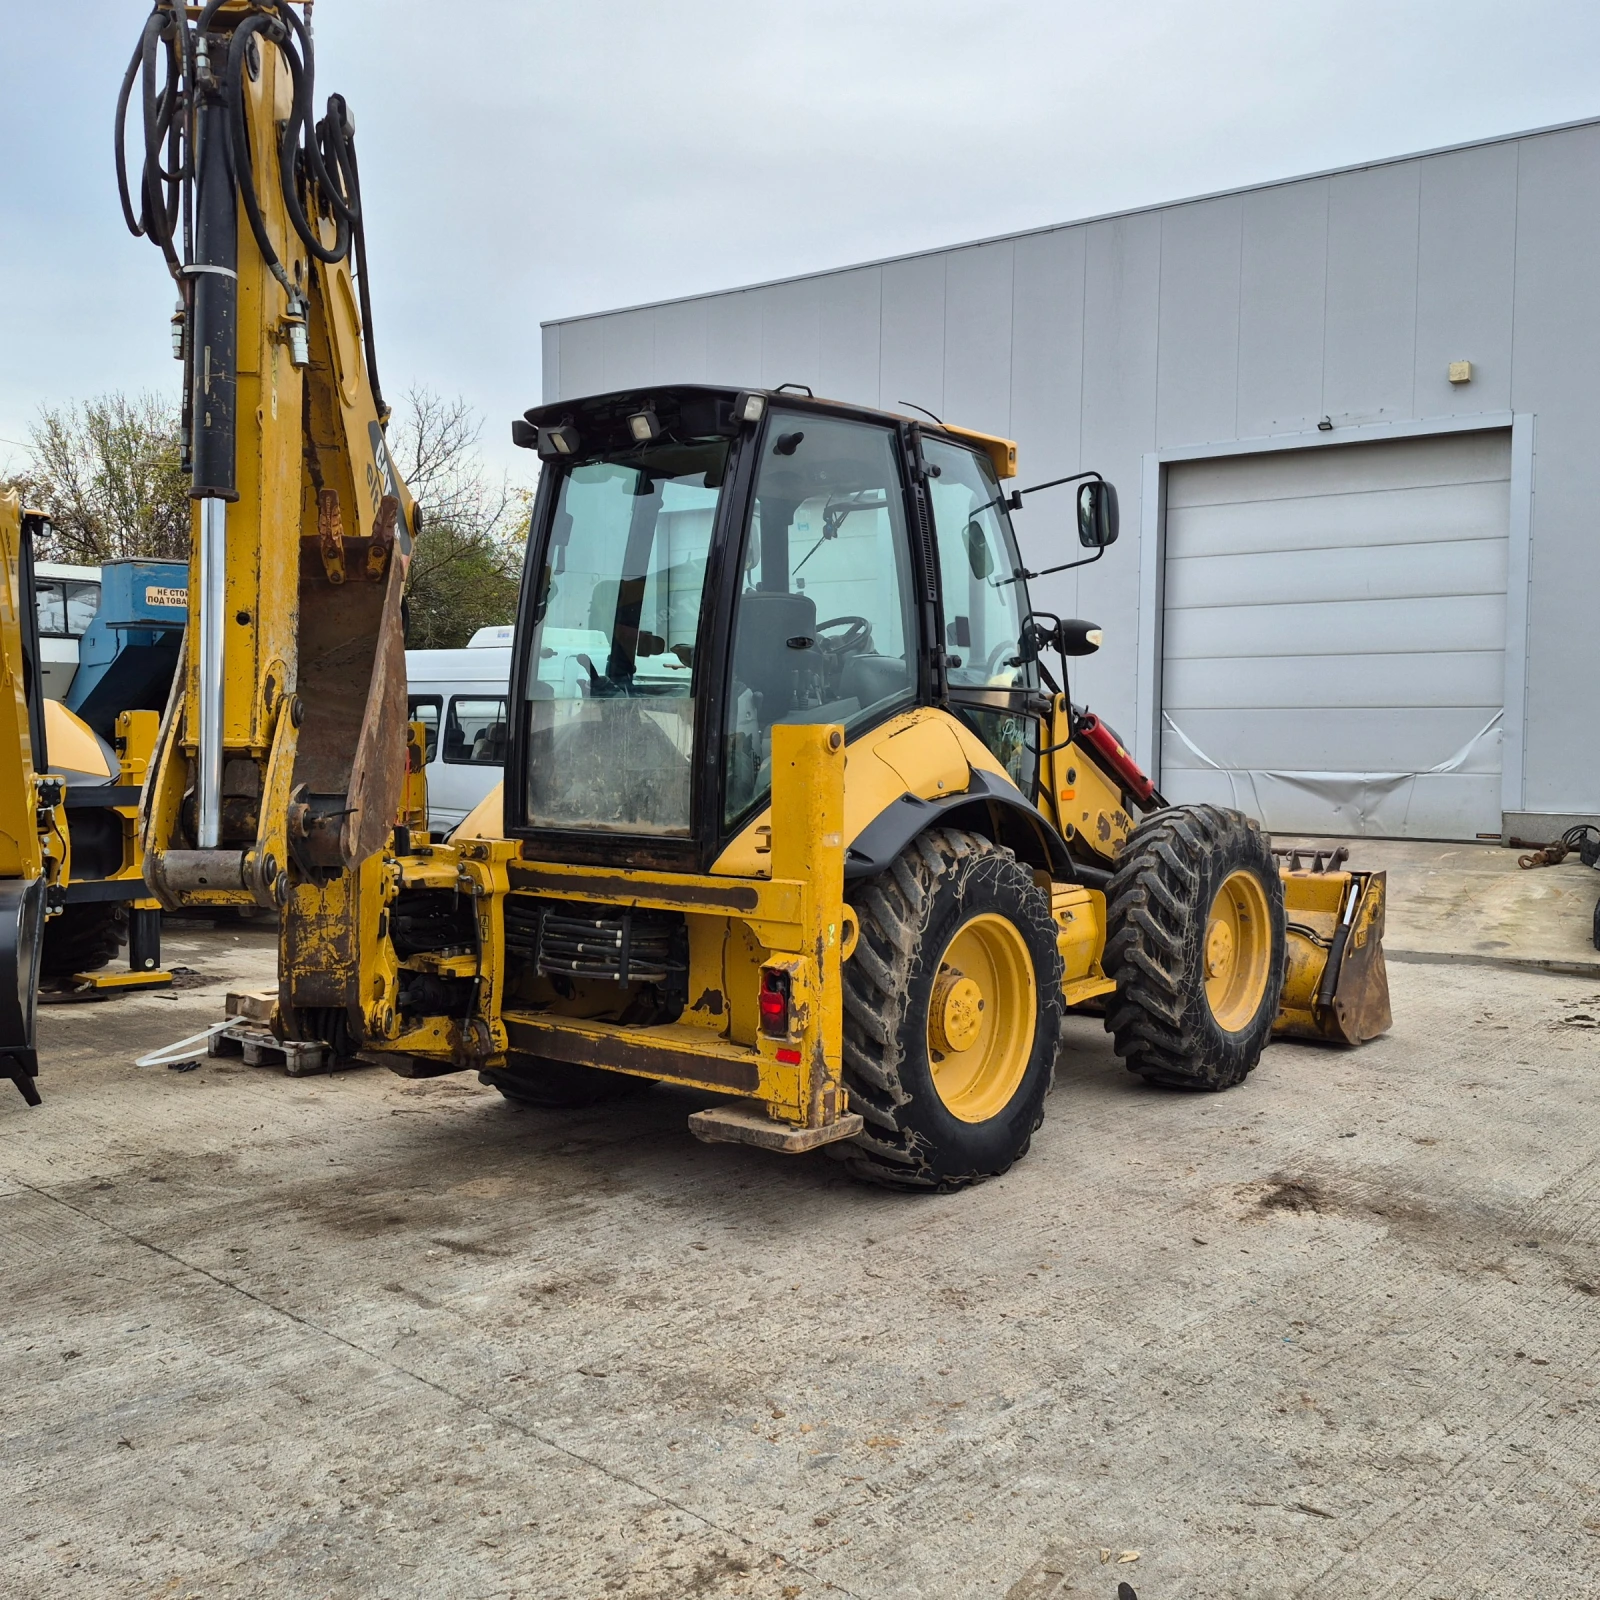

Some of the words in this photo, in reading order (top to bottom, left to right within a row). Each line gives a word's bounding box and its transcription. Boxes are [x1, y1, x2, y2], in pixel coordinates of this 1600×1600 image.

[157, 588, 168, 596] НЕ
[147, 595, 165, 605] ПОД
[166, 597, 188, 605] ТОВА
